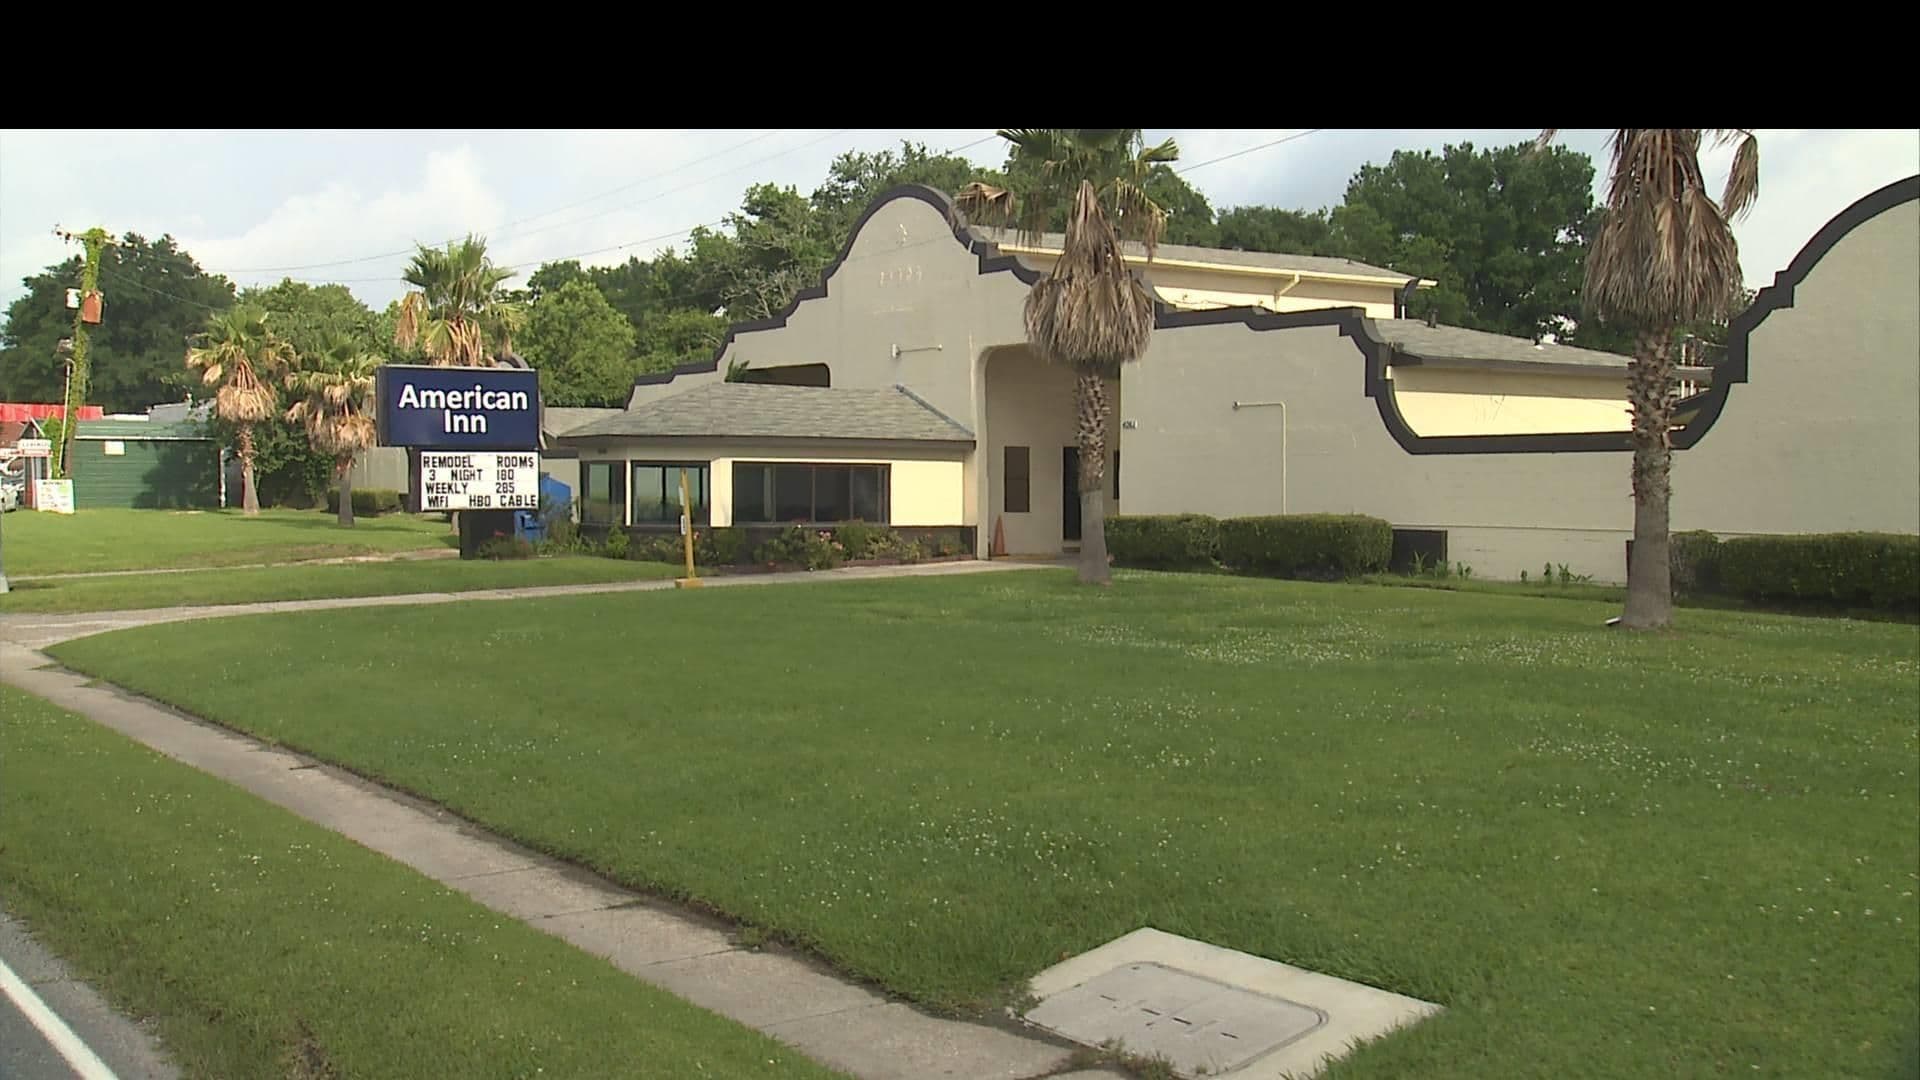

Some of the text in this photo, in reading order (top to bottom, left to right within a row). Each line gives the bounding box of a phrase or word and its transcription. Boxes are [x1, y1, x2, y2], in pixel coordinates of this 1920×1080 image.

[399, 384, 528, 410] American
[444, 409, 487, 433] Inn
[423, 456, 534, 468] REMODEL ROOMS
[429, 469, 514, 481] 3 NIGHT 180
[425, 482, 515, 494] WEEKLY 285
[427, 495, 536, 508] WIFI HBO CABLE
